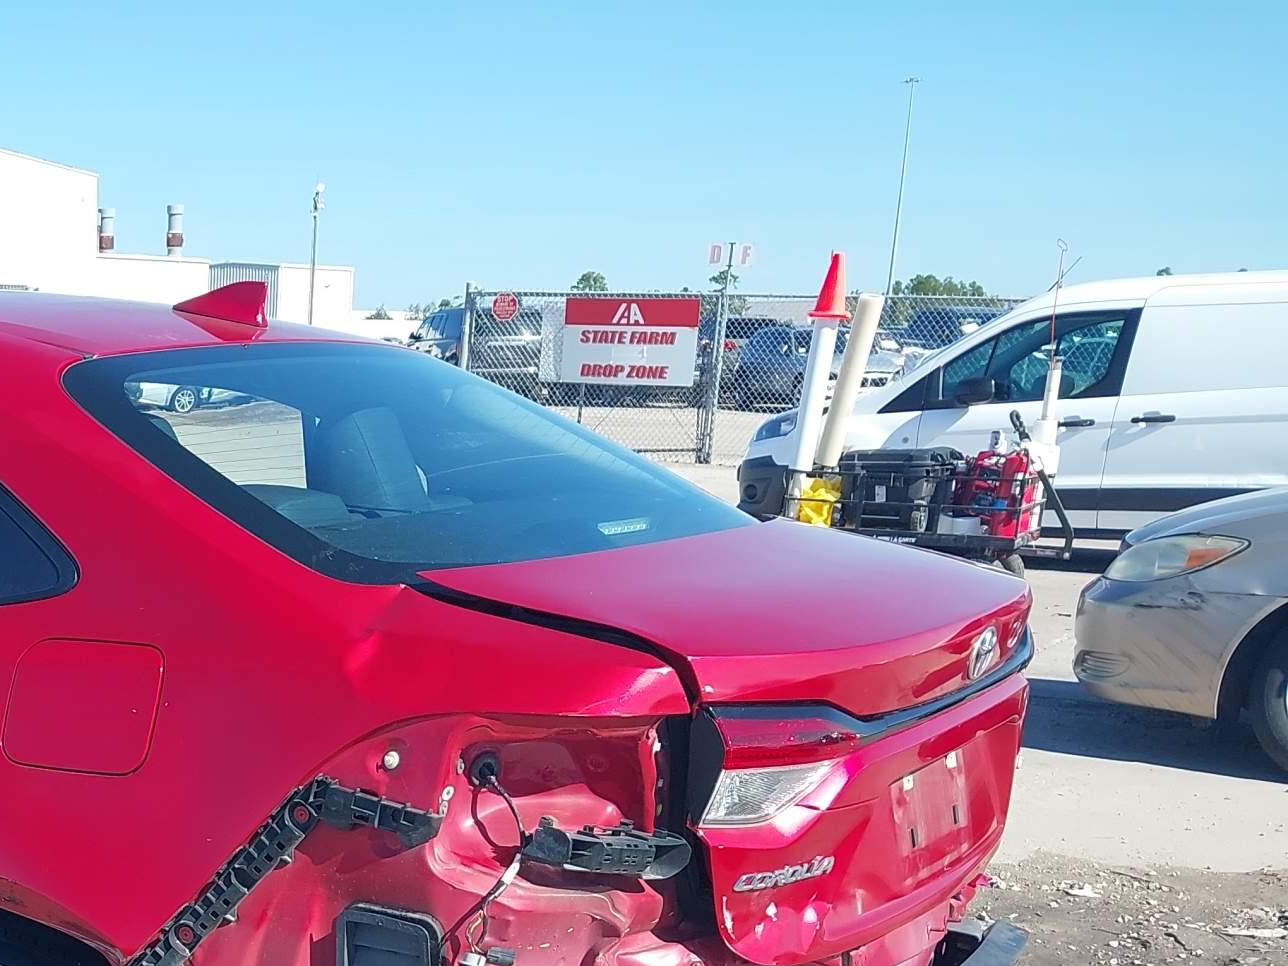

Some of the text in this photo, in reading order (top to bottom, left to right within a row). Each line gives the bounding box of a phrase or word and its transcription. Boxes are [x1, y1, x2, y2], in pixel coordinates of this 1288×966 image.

[580, 330, 677, 346] STATE FARM
[580, 363, 669, 380] DROP ZONE
[733, 855, 835, 892] COROLLA
